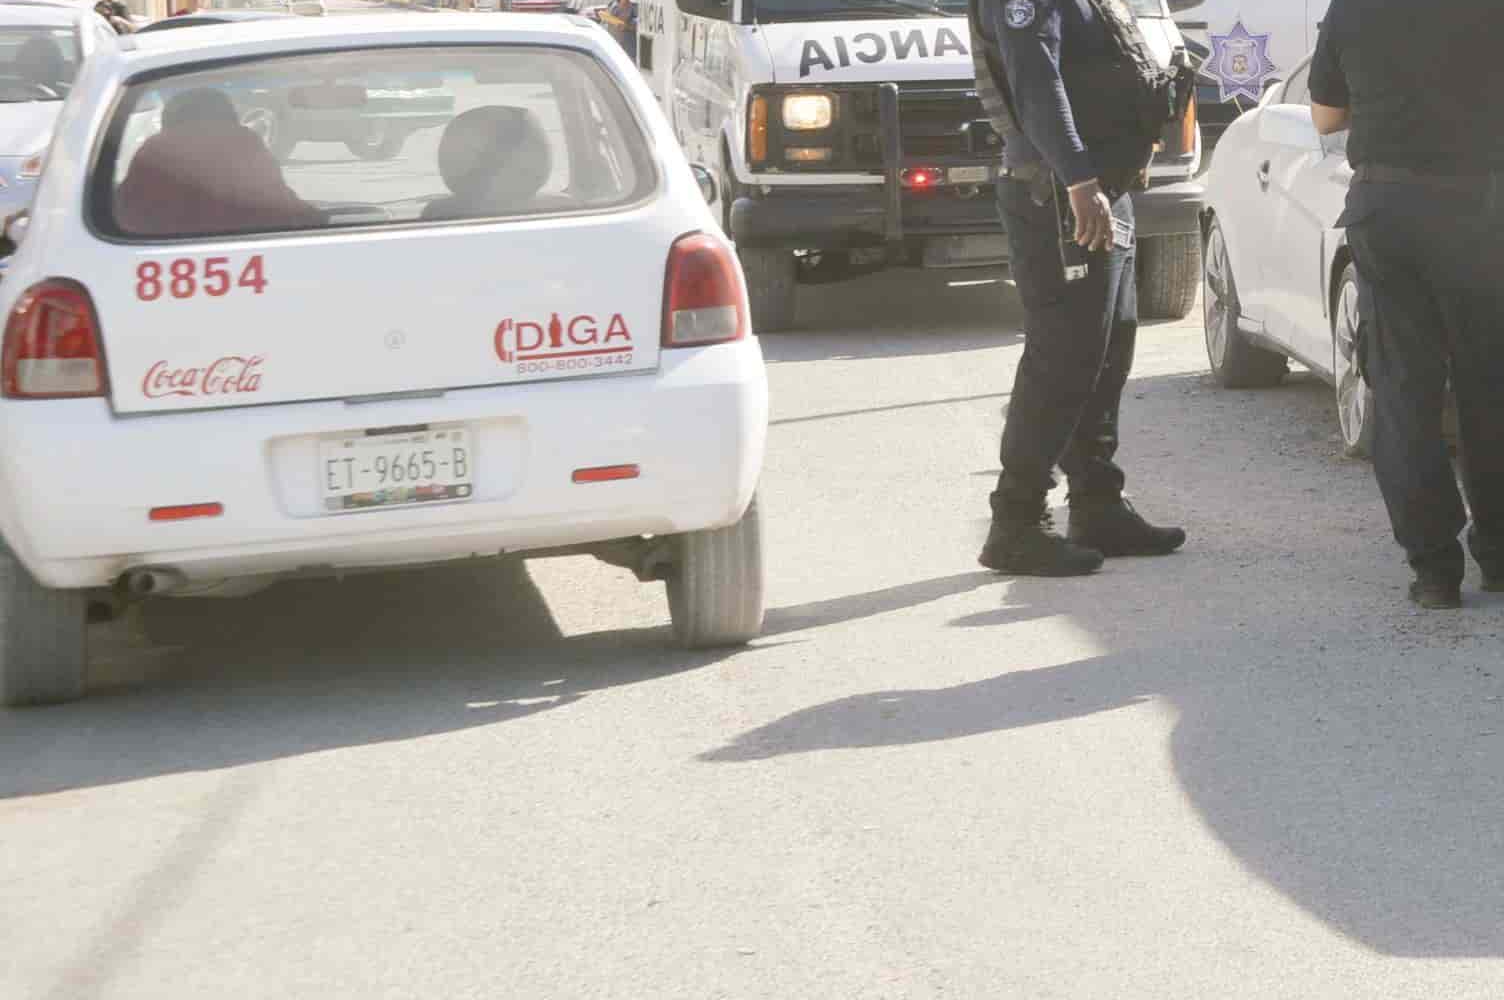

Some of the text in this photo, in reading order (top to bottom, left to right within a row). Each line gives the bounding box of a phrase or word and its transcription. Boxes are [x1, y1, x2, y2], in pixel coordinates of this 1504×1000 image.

[136, 254, 268, 301] 8854
[142, 354, 267, 399] Coca-Cola
[327, 447, 467, 491] ET-9665-B
